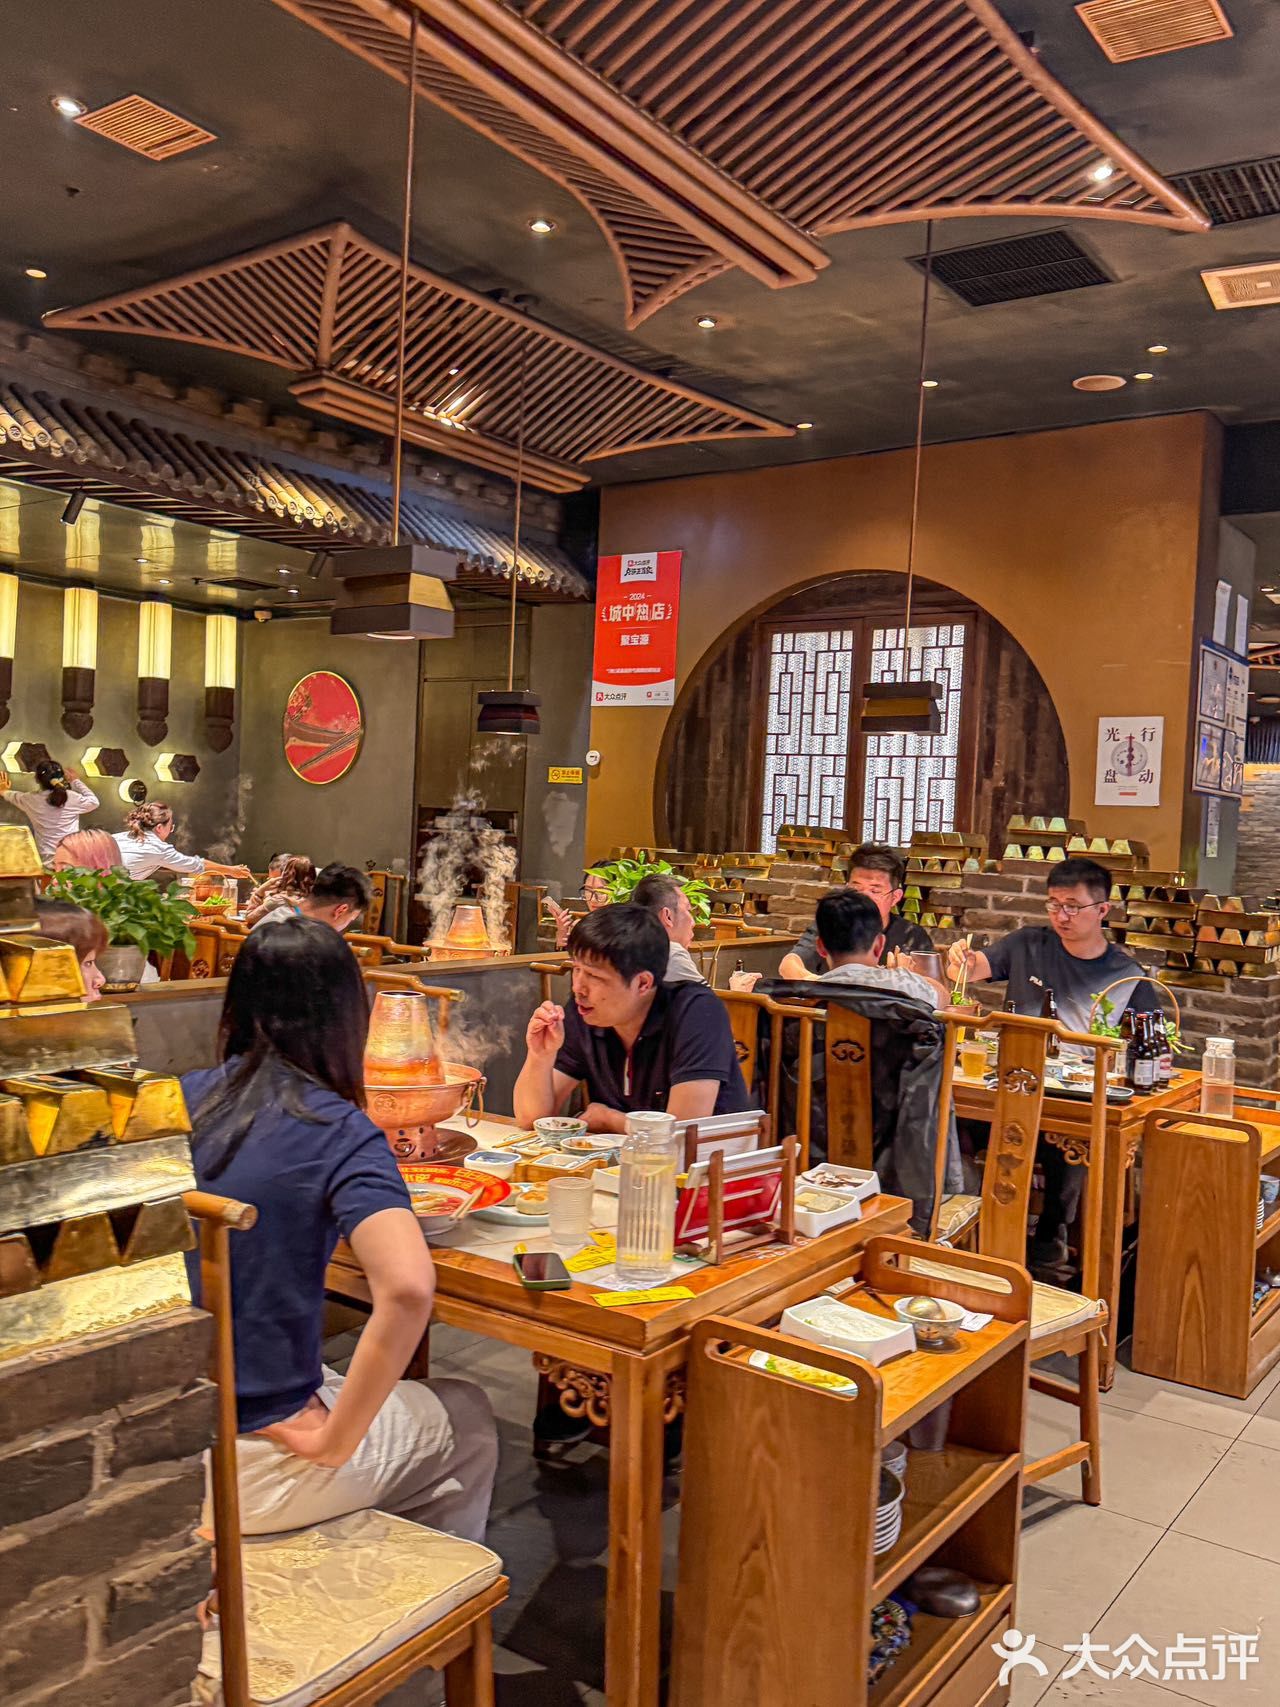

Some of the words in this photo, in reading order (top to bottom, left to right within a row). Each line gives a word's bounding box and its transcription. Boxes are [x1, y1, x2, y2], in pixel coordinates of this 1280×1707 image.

[609, 602, 665, 622] 城中热店
[604, 692, 627, 701] 大众点评
